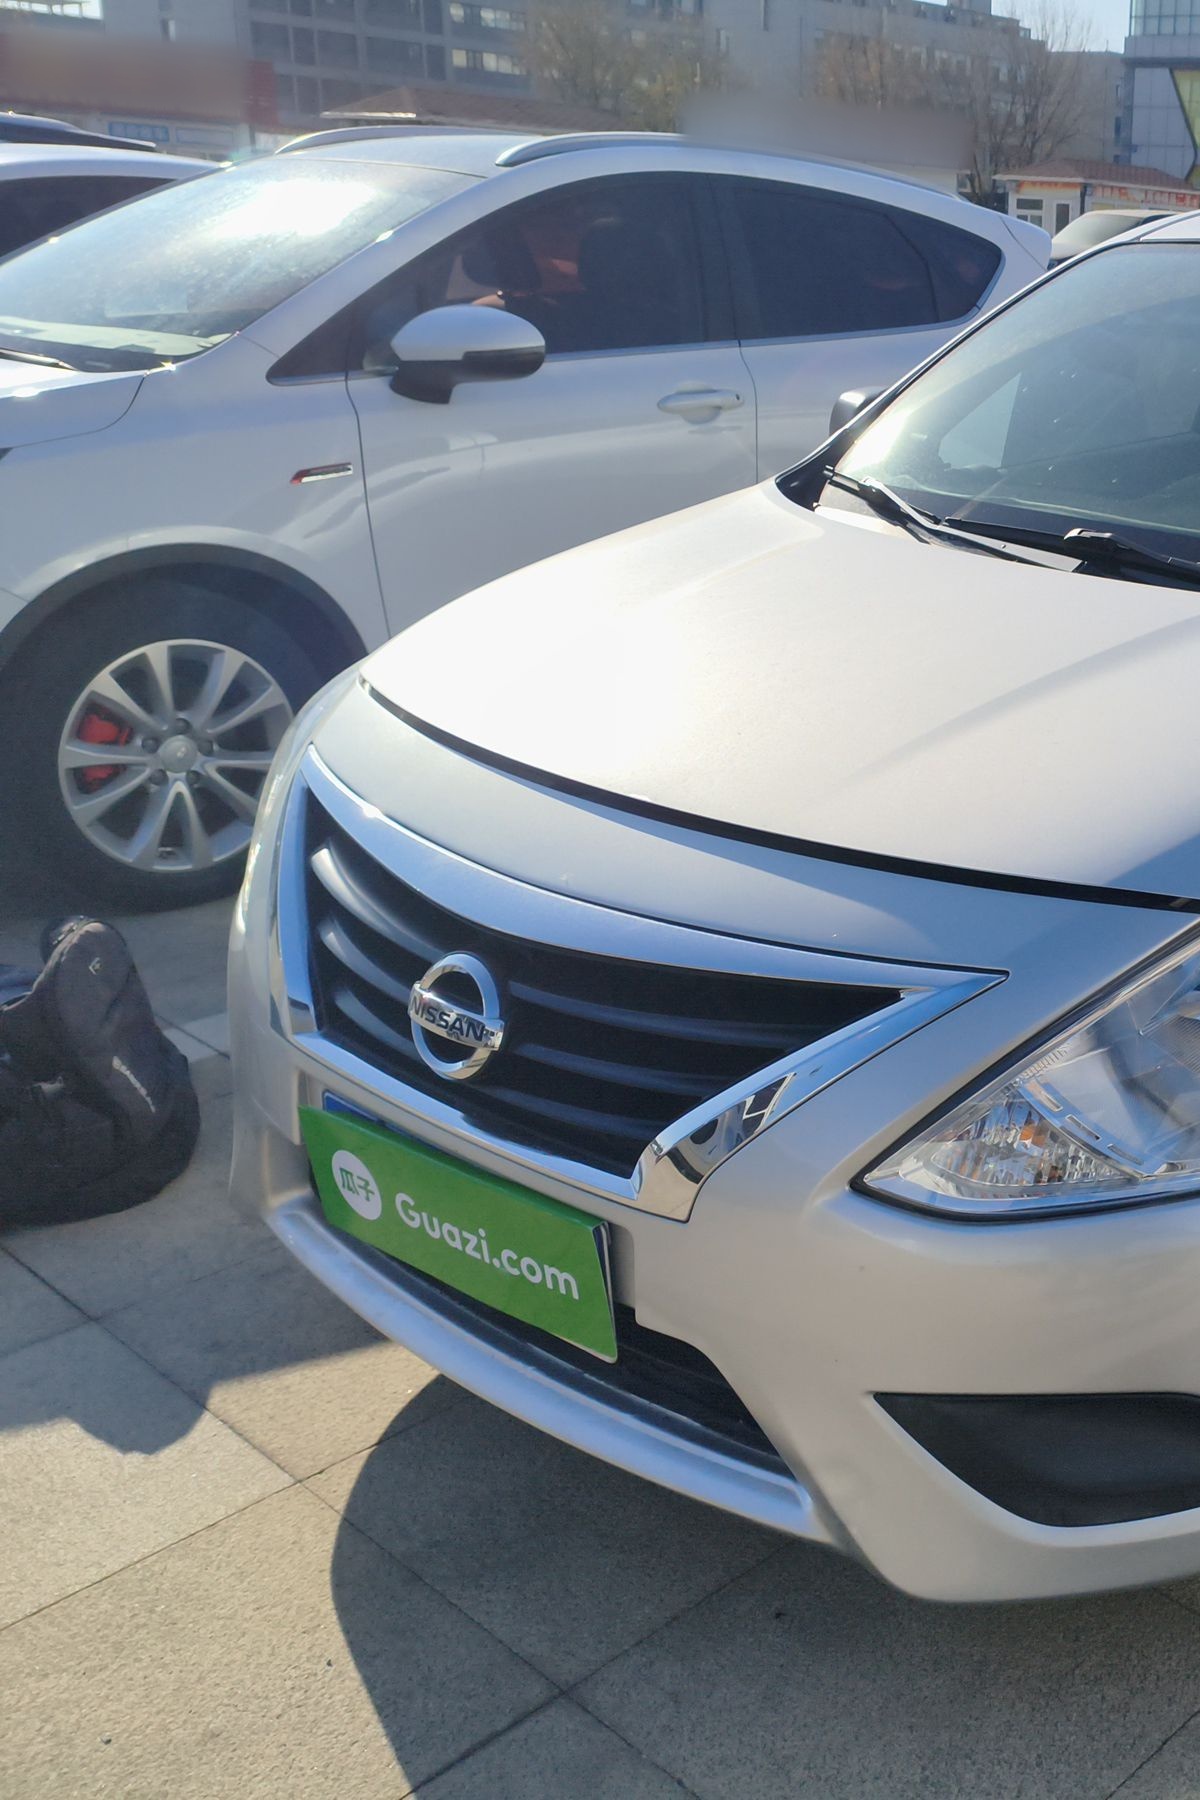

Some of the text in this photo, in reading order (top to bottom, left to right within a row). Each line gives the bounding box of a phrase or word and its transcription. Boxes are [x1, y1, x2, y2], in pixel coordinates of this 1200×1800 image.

[410, 993, 485, 1041] NISSAN
[338, 1166, 376, 1203] 瓜子
[394, 1192, 580, 1301] Guazi.com
